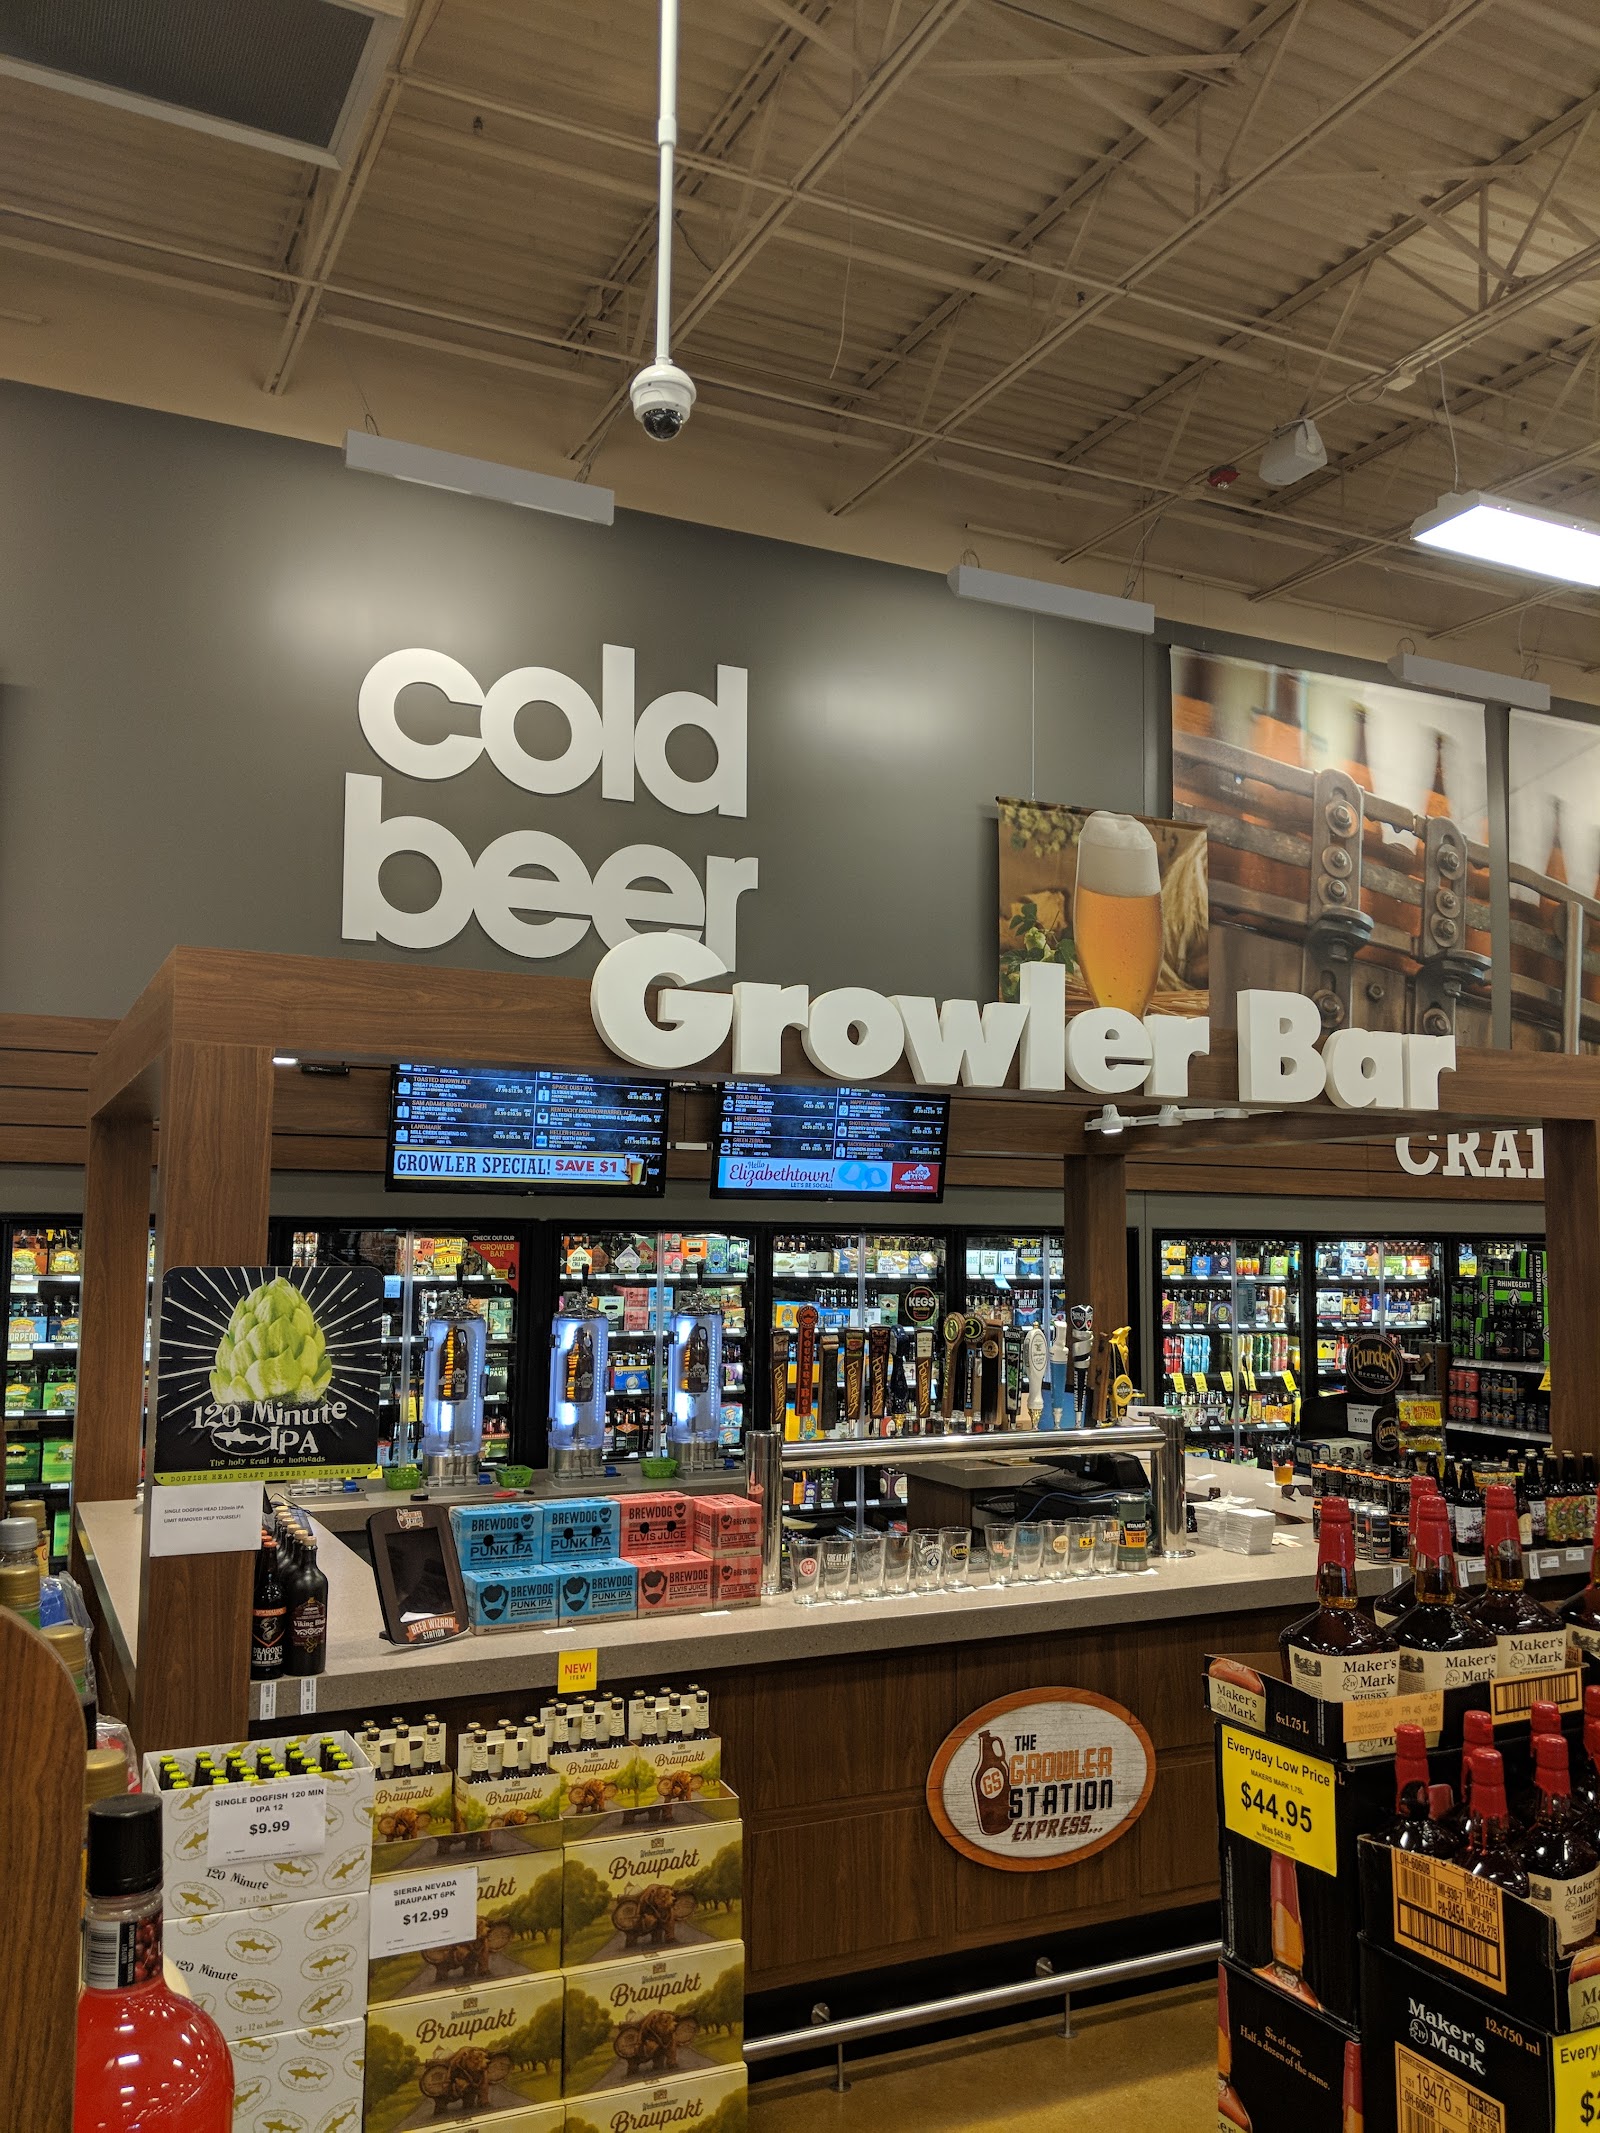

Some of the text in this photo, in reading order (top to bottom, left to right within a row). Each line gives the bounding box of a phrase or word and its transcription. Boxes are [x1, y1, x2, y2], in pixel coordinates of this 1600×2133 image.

[358, 643, 748, 818] cold
[341, 772, 759, 973] beer
[590, 931, 1456, 1110] Growler Bar
[397, 1154, 617, 1175] GROWLER SPECIAL! SAVE $1
[729, 1163, 836, 1187] Elizabethtown!
[490, 1250, 504, 1258] BAR
[1497, 1280, 1530, 1289] RHINEGEIST
[908, 1296, 934, 1307] KEGS
[803, 1329, 811, 1386] COUNTRY
[1352, 1344, 1397, 1380] Founders
[1358, 1370, 1389, 1380] Brewing
[774, 1363, 785, 1421] Founders
[847, 1359, 859, 1417] Founders
[872, 1356, 885, 1414] Founders
[918, 1360, 930, 1416] Founders
[801, 1388, 810, 1413] BOY
[191, 1400, 347, 1429] 120 Minute
[270, 1426, 319, 1455] IPA
[210, 1456, 326, 1467] The holy grail for hopheads
[170, 1474, 208, 1482] DOGFISH
[268, 1470, 307, 1478] BREWERY
[318, 1468, 362, 1476] DELAWARE
[552, 1510, 598, 1525] BREWDOG
[629, 1506, 672, 1520] BREWDOG
[733, 1516, 758, 1526] BREWDOG
[472, 1517, 519, 1532] BREWDOG
[551, 1536, 611, 1550] PUNK IPA
[628, 1530, 686, 1542] ELVIS JUICE
[720, 1534, 756, 1542] ELVIS JUICE
[470, 1543, 533, 1558] PUNK IPA
[511, 1583, 554, 1598] BREWDOG
[592, 1575, 632, 1590] BREWDOG
[670, 1584, 688, 1592] ELVIS
[721, 1584, 756, 1594] ELVIS JUICE
[511, 1598, 552, 1610] PUNK IPA
[592, 1592, 616, 1600] PUNK
[410, 1617, 454, 1634] BEER WIZARD
[423, 1628, 445, 1640] STATION
[253, 1645, 283, 1654] DRAGON'S
[1510, 1637, 1564, 1652] Maker's
[256, 1653, 280, 1661] MILK
[1343, 1658, 1397, 1674] Maker's
[1445, 1652, 1497, 1668] Maker's
[1527, 1651, 1562, 1666] Mark
[564, 1662, 592, 1675] NEW!
[1462, 1668, 1495, 1684] Mark
[1360, 1674, 1396, 1688] Mark
[1217, 1683, 1258, 1709] Maker's
[1352, 1692, 1388, 1700] WHISKY
[1228, 1701, 1256, 1723] Mark
[1276, 1711, 1310, 1734] 6x1.75 L
[1014, 1734, 1037, 1752] THE
[566, 1758, 620, 1775] Braupakt
[655, 1750, 706, 1767] Braupakt
[1009, 1746, 1113, 1786] GROWLER
[1228, 1736, 1330, 1787] Everyday Low Price
[982, 1771, 1002, 1796] GS
[1250, 1769, 1304, 1795] MAKERS MARK 1.75L
[215, 1788, 324, 1806] SINGLE DOGFISH 120 MIN
[376, 1786, 434, 1804] Braupakt
[486, 1788, 543, 1806] Braupakt
[1008, 1780, 1113, 1820] STATION
[1241, 1780, 1312, 1833] $44.95
[249, 1820, 290, 1836] $9.99
[1011, 1814, 1103, 1842] EXPRESS...
[1261, 1822, 1292, 1842] Was $45.99
[608, 1849, 700, 1880] Braupakt
[206, 1868, 269, 1890] 120 Minute
[394, 1880, 457, 1896] SIERRA NEVADA
[394, 1890, 456, 1906] BRAUPAKT 6PK
[402, 1908, 449, 1927] $12.99
[198, 1963, 238, 1980] Minute
[610, 1972, 702, 2007] Braupakt
[416, 2008, 516, 2044] Braupakt
[1408, 1996, 1486, 2053] Maker's
[1264, 2026, 1303, 2058] Six of one.
[1485, 2016, 1541, 2057] 12x750 ml
[1240, 2024, 1330, 2090] Half a dozen of the same.
[1430, 2030, 1487, 2076] Mark
[1416, 2072, 1452, 2113] 19476
[610, 2098, 703, 2133] Braupakt
